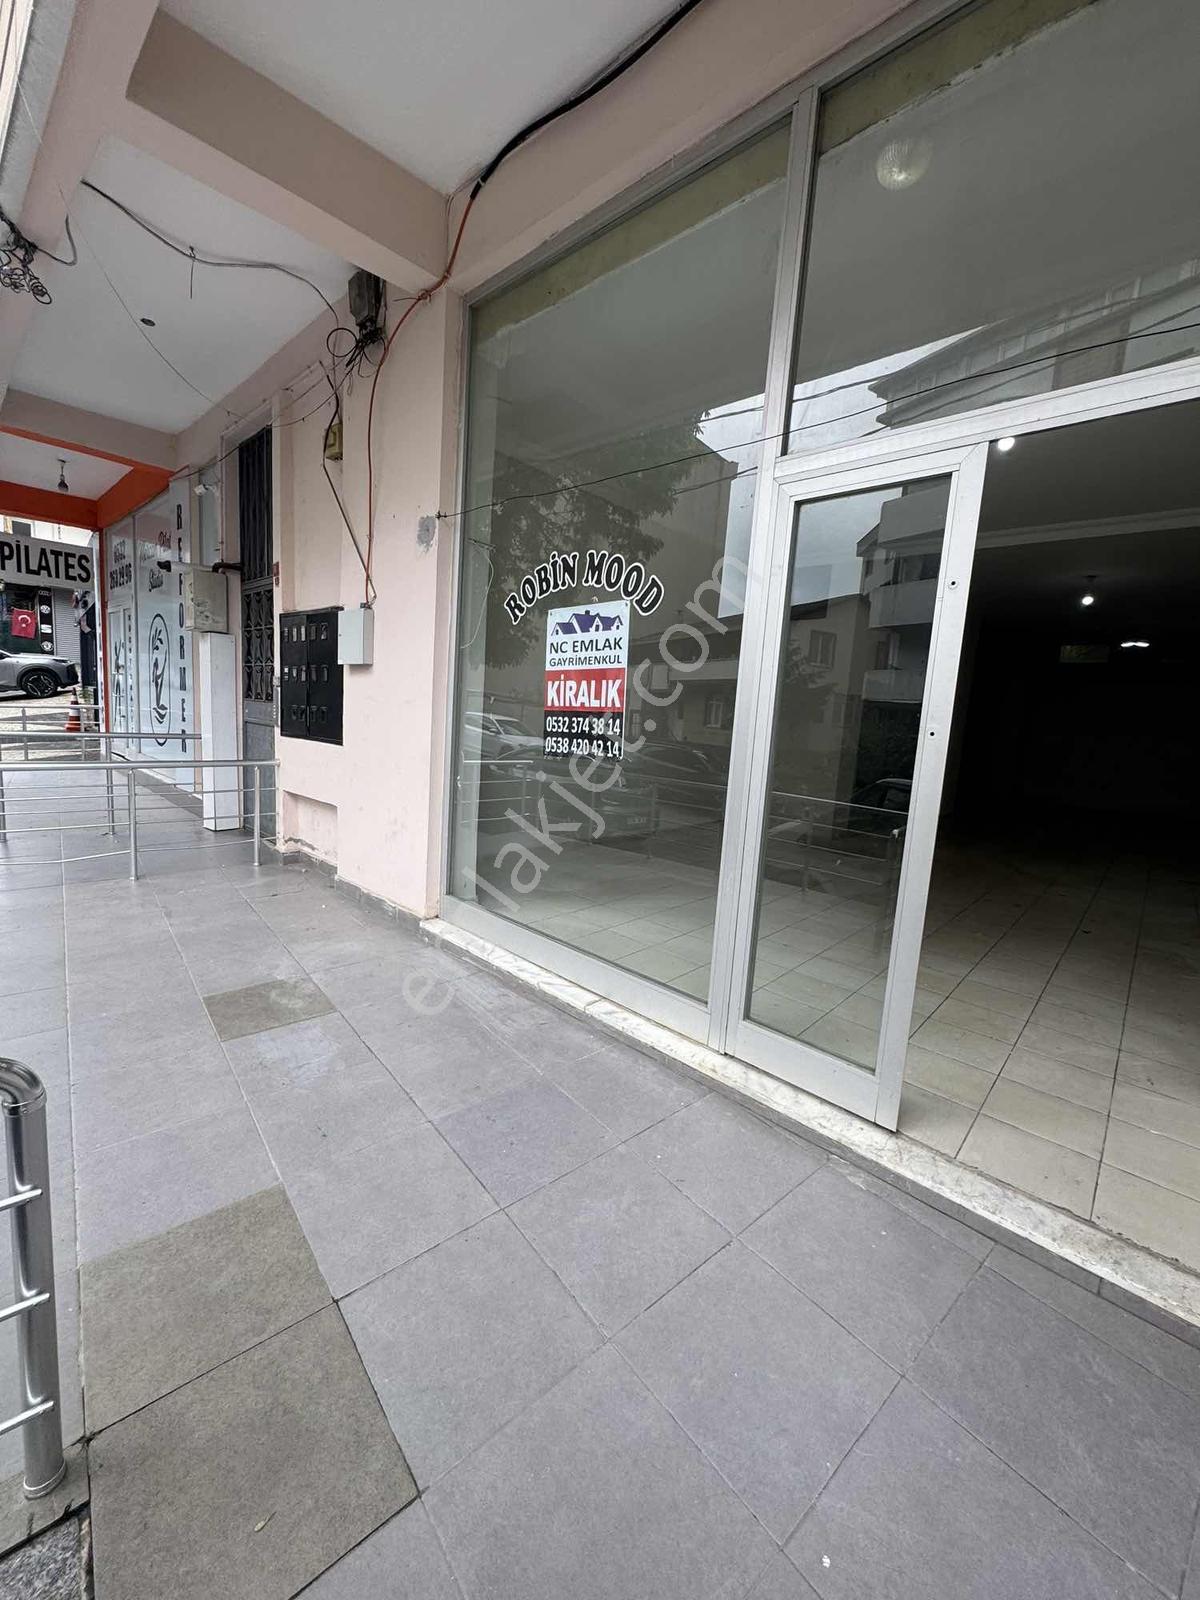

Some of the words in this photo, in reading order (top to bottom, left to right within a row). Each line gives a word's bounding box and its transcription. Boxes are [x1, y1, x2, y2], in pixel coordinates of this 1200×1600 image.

[0, 540, 91, 584] PİLATES
[504, 551, 579, 624] ROBİN
[582, 550, 664, 615] MOOD
[550, 641, 568, 654] NC
[572, 637, 623, 653] EMLAK
[549, 654, 622, 667] GAYRİMENKUL
[547, 674, 622, 707] KİRALIK
[546, 716, 569, 732] 0532
[571, 716, 589, 734] 374
[592, 718, 605, 735] 38
[607, 718, 620, 735] 14
[545, 737, 569, 753] 0538
[571, 738, 589, 755] 420
[592, 740, 604, 756] 42
[607, 740, 620, 758] 14
